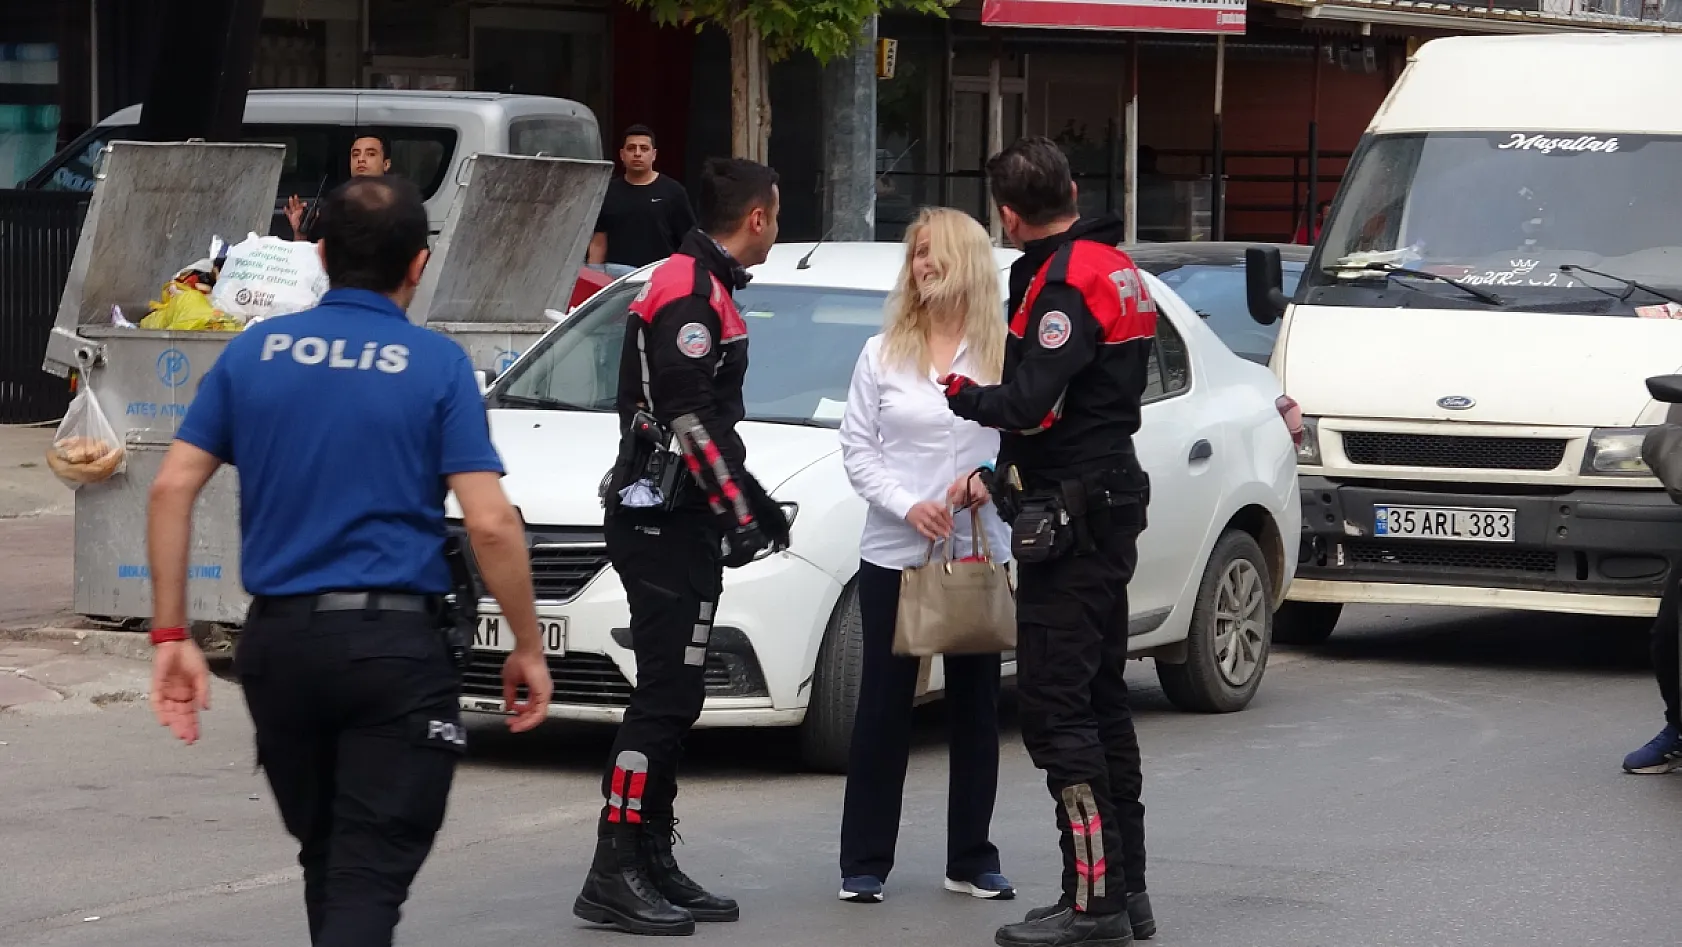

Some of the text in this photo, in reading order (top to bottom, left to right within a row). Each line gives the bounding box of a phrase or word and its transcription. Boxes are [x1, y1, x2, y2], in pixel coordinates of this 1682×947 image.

[1498, 133, 1620, 154] Maşallah
[1390, 510, 1510, 538] 35 ARL 383
